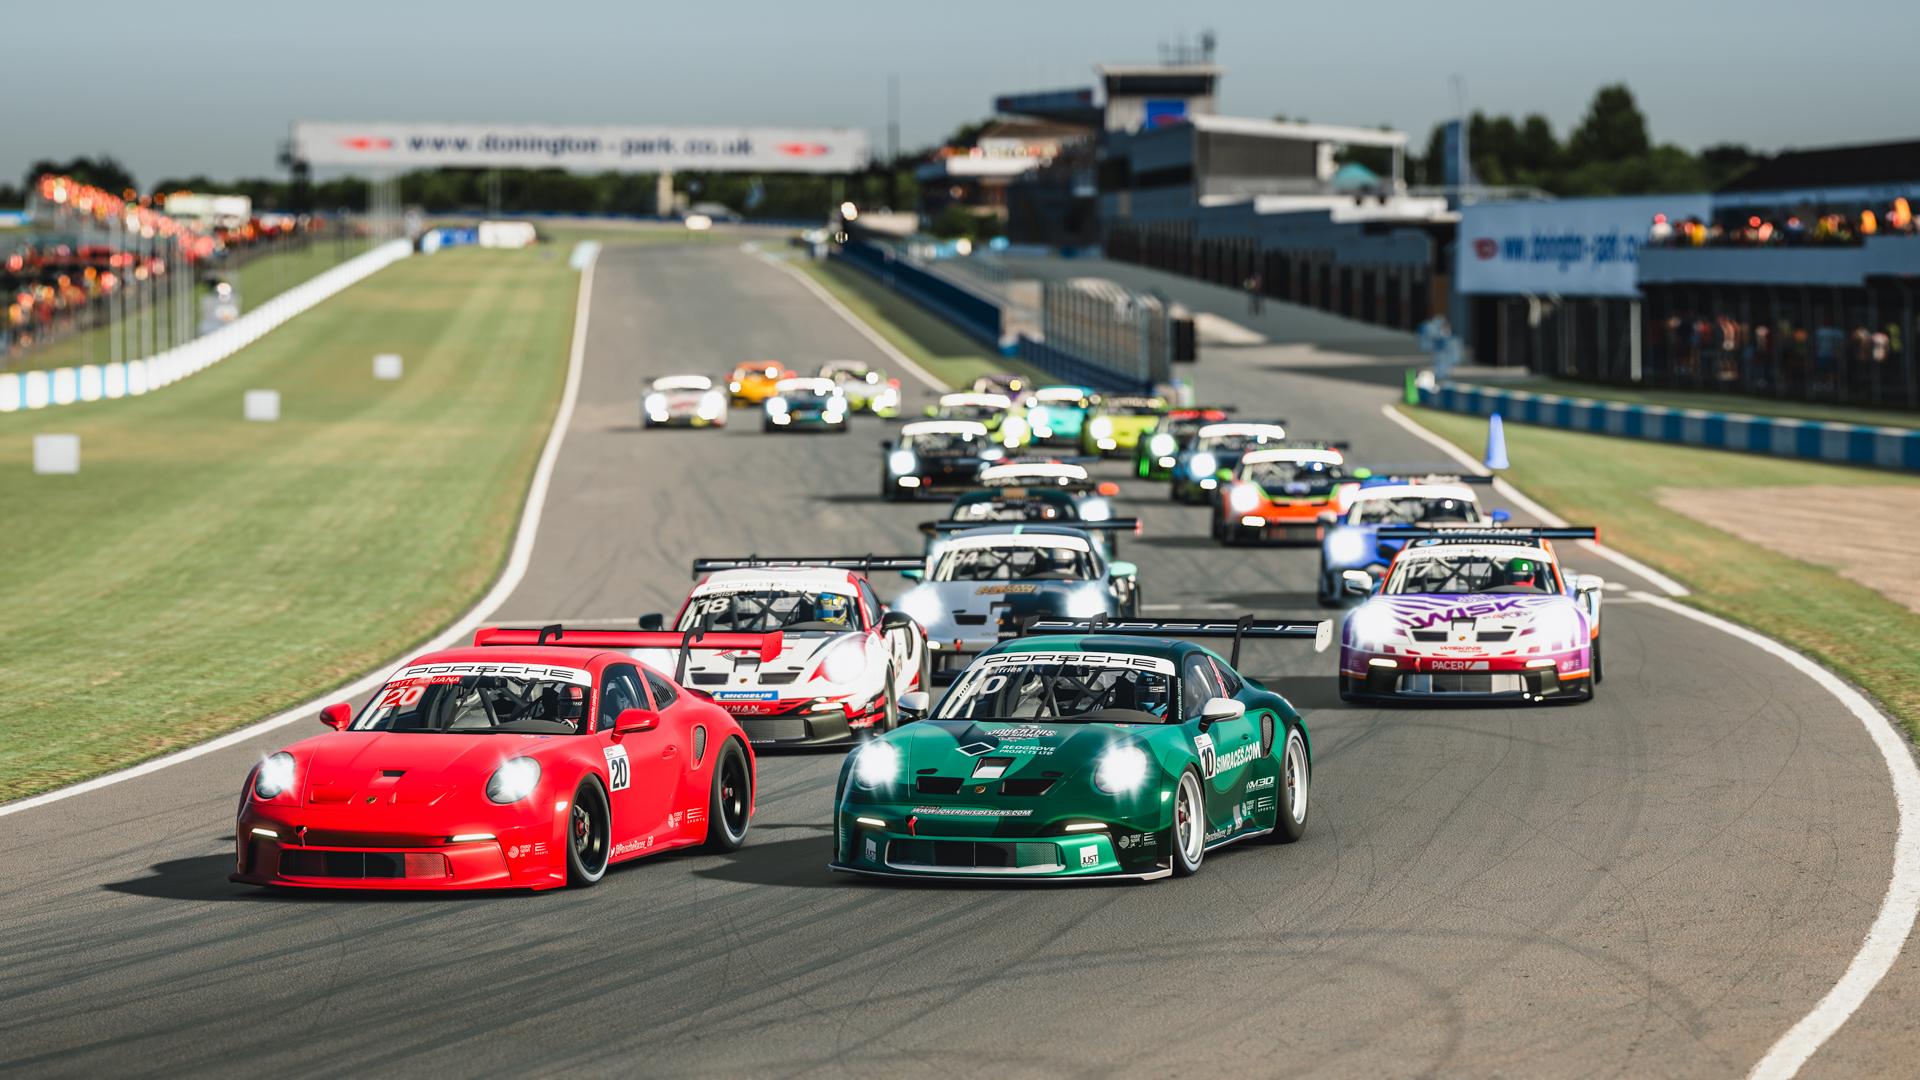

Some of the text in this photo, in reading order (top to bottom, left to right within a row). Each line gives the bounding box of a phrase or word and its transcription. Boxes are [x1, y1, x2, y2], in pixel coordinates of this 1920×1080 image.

[700, 598, 730, 614] 18
[1036, 620, 1318, 631] PORSCHE
[983, 654, 1157, 669] PORSCHE
[1432, 661, 1465, 671] PACER
[404, 665, 575, 680] PORSCHE
[380, 685, 425, 710] 20
[1202, 748, 1215, 778] 10
[1216, 741, 1261, 773] SIMRACES.COM
[611, 757, 628, 790] 20
[1082, 854, 1098, 865] JUST
